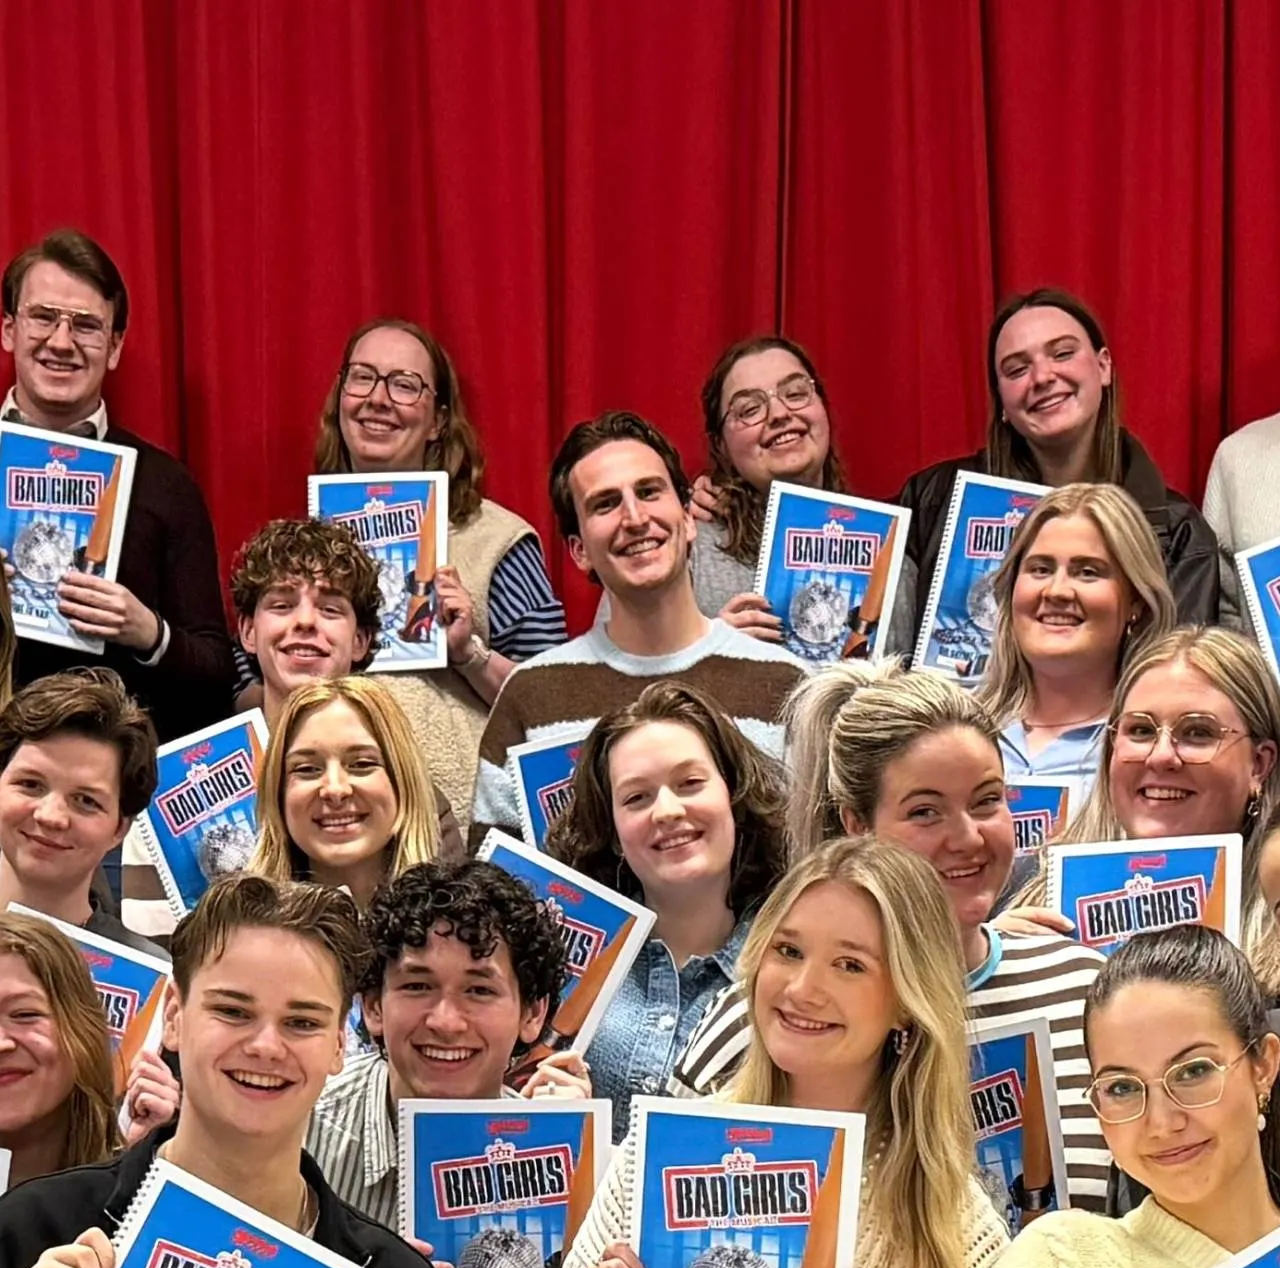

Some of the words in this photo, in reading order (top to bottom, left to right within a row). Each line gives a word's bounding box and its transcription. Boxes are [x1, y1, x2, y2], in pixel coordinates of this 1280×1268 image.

[15, 475, 48, 503] BAD
[52, 479, 96, 506] GIRLS
[338, 516, 369, 542] AD
[373, 509, 417, 540] GIRLS
[973, 525, 1005, 552] BAD
[792, 536, 824, 563] BAD
[828, 538, 872, 566] GIRLS
[166, 785, 207, 827] BAD
[199, 760, 252, 807] GIRLS
[1087, 896, 1132, 938] BAD
[1135, 886, 1198, 929] GIRLS
[971, 1082, 1017, 1130] RLS
[443, 1165, 494, 1208] BAD
[497, 1155, 565, 1201] GIRLS
[675, 1176, 729, 1219] BAD
[734, 1172, 807, 1217] GIRLS
